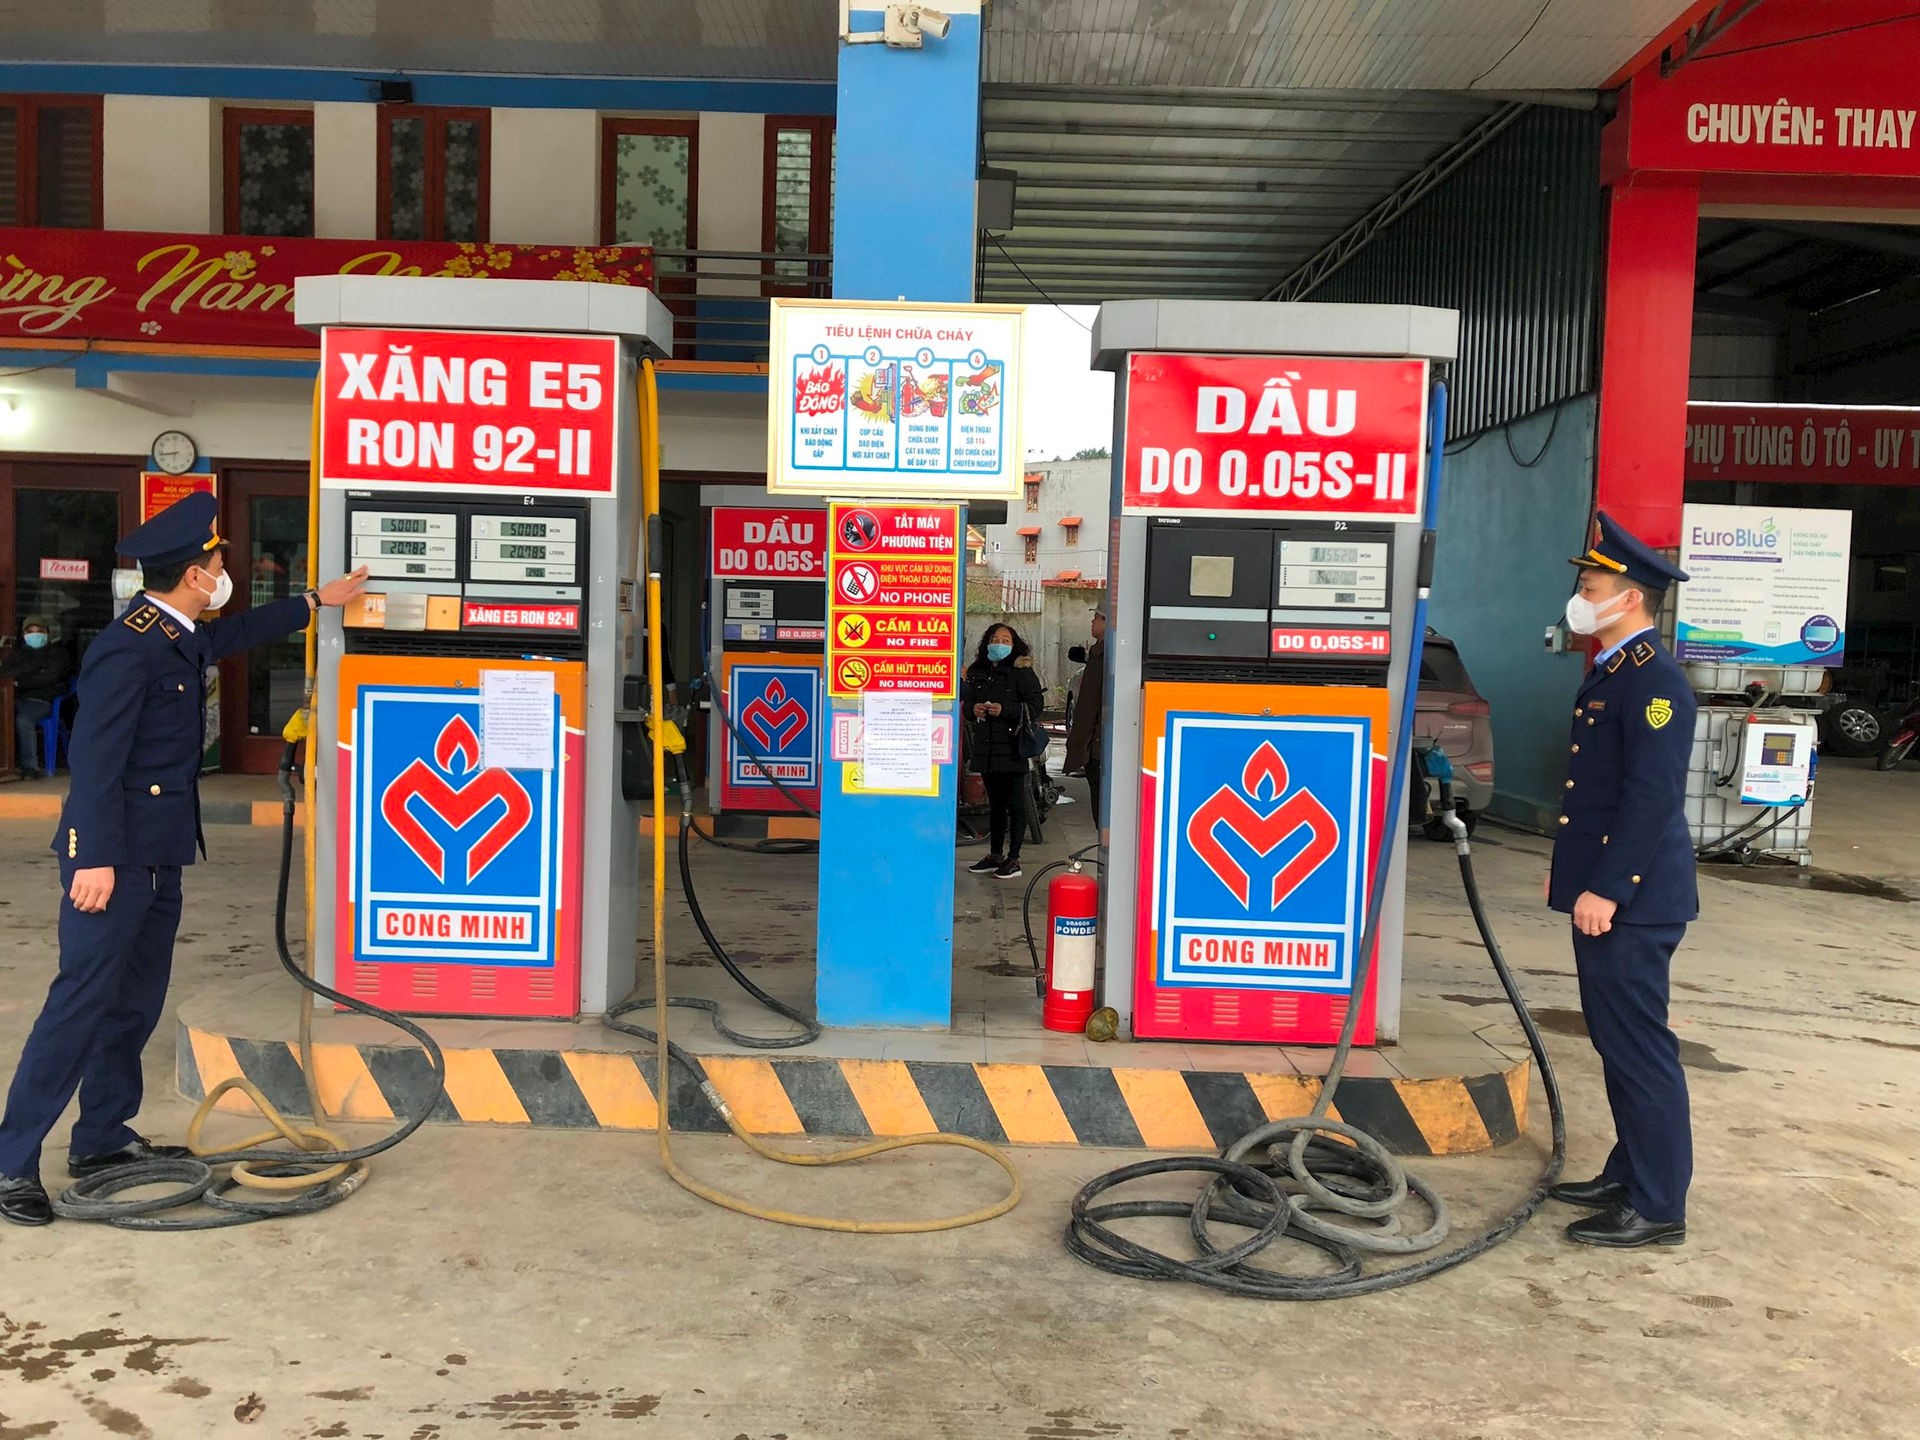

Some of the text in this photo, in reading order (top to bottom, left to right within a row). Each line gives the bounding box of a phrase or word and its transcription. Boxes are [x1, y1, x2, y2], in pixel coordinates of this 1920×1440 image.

[1687, 97, 1917, 149] CHUYÊN: THAY
[825, 324, 974, 341] TIÊU LỆNH CHỮA CHÁY
[819, 350, 824, 360] 1
[870, 351, 876, 361] 2
[922, 353, 929, 363] 3
[974, 355, 981, 365] 4
[338, 344, 602, 411] XĂNG E5
[805, 379, 830, 394] BÁO
[1196, 371, 1357, 436] DẦU
[347, 418, 592, 476] RON 92-II
[1732, 416, 1794, 466] TÙNG
[1800, 418, 1816, 467] Ô
[1823, 419, 1851, 467] TÔ
[1874, 428, 1904, 469] UY
[1139, 446, 1407, 501] DO 0.05S-II
[894, 512, 941, 529] TẮT MÁY
[1334, 521, 1348, 530] D2
[743, 515, 814, 544] DẦU
[1692, 526, 1777, 548] EuroBlue
[881, 534, 953, 550] PHƯƠNG TIỆN
[720, 548, 748, 570] DO
[880, 591, 951, 604] NO PHONE
[469, 606, 574, 626] XĂNG E5 RON 92-II
[875, 617, 949, 633] CẤM LỬA
[886, 638, 938, 646] NO FIRE
[1278, 635, 1384, 650] DO 0,05S-II
[873, 660, 947, 675] CẤM HÚT THUỐC
[879, 680, 944, 688] NO SMOKING
[777, 766, 805, 777] MINH
[386, 912, 525, 940] CONG MINH
[1056, 925, 1096, 935] POWDER
[1188, 938, 1328, 967] CONG MINH
